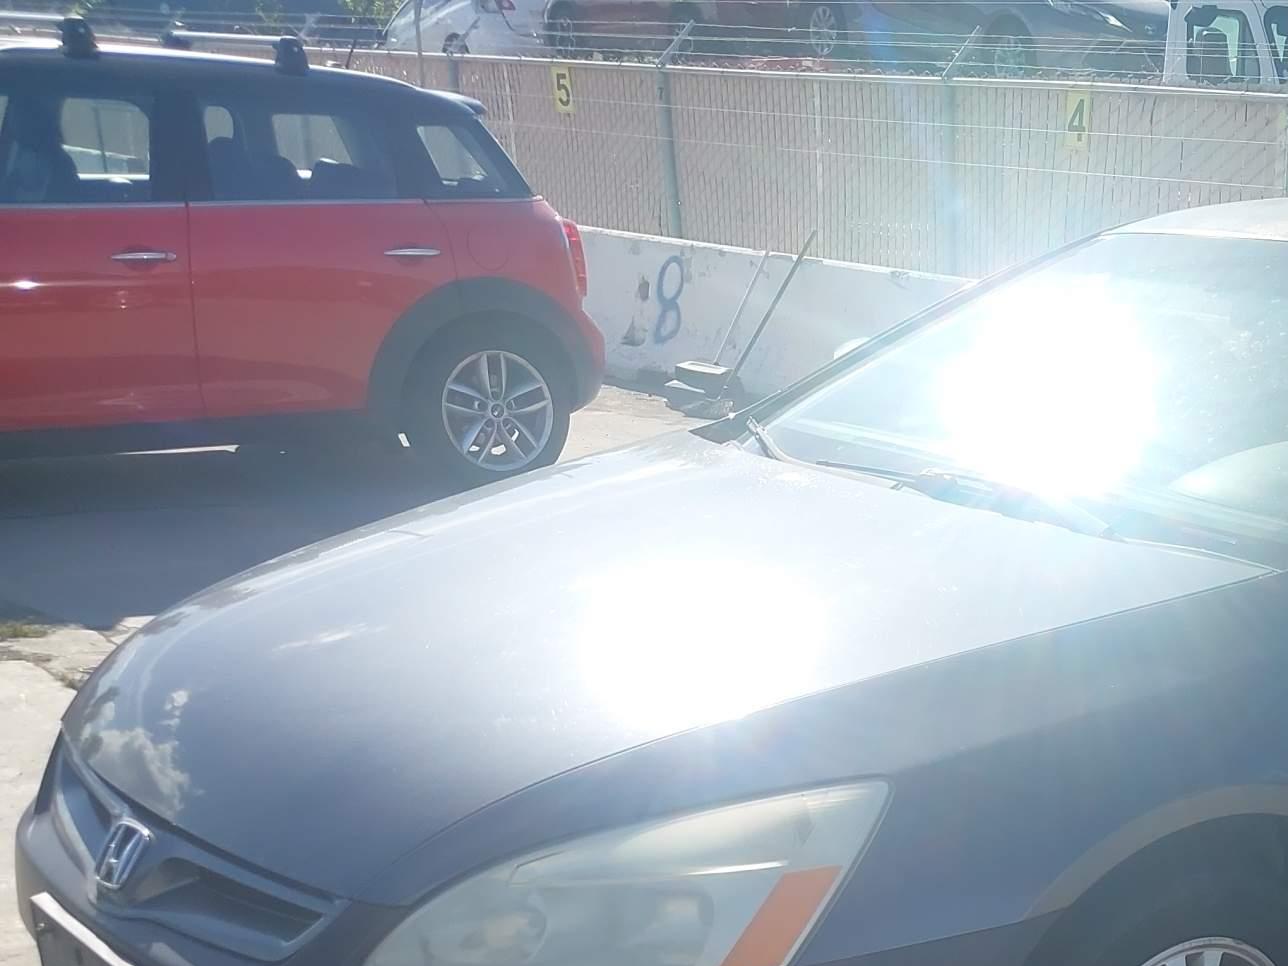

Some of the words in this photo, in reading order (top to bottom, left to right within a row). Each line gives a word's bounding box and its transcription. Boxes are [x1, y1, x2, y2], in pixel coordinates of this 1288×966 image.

[556, 72, 571, 107] 5
[1067, 98, 1086, 142] 4
[654, 255, 684, 345] 8
